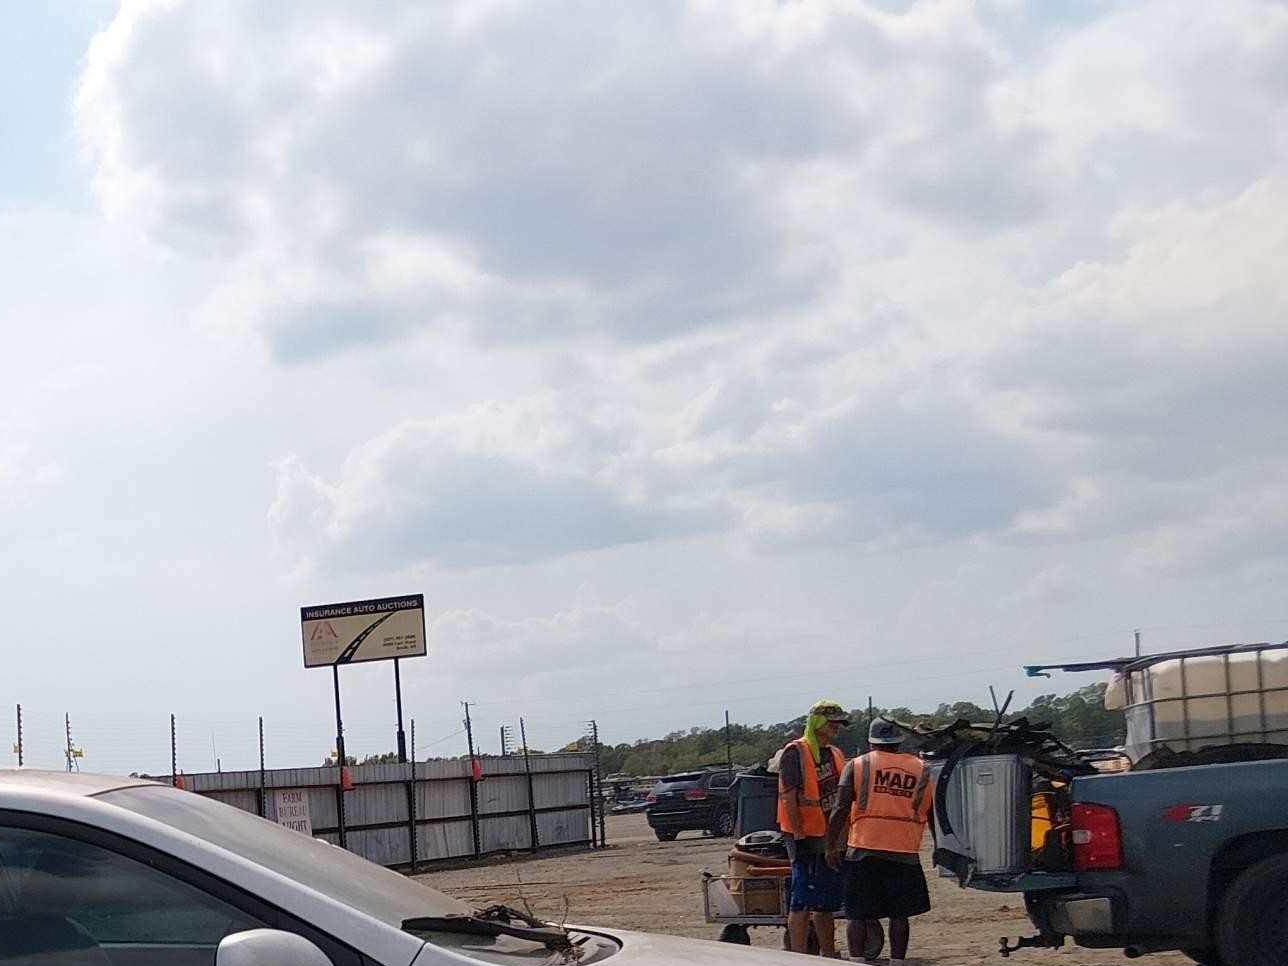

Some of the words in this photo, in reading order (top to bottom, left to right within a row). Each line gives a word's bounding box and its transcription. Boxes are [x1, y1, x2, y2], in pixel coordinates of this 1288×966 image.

[306, 607, 351, 619] INSURANCE
[353, 604, 375, 614] AUTO
[377, 600, 418, 611] AUCTIONS
[874, 769, 917, 790] MAD
[282, 791, 302, 803] FARM
[279, 806, 306, 817] BUREAU
